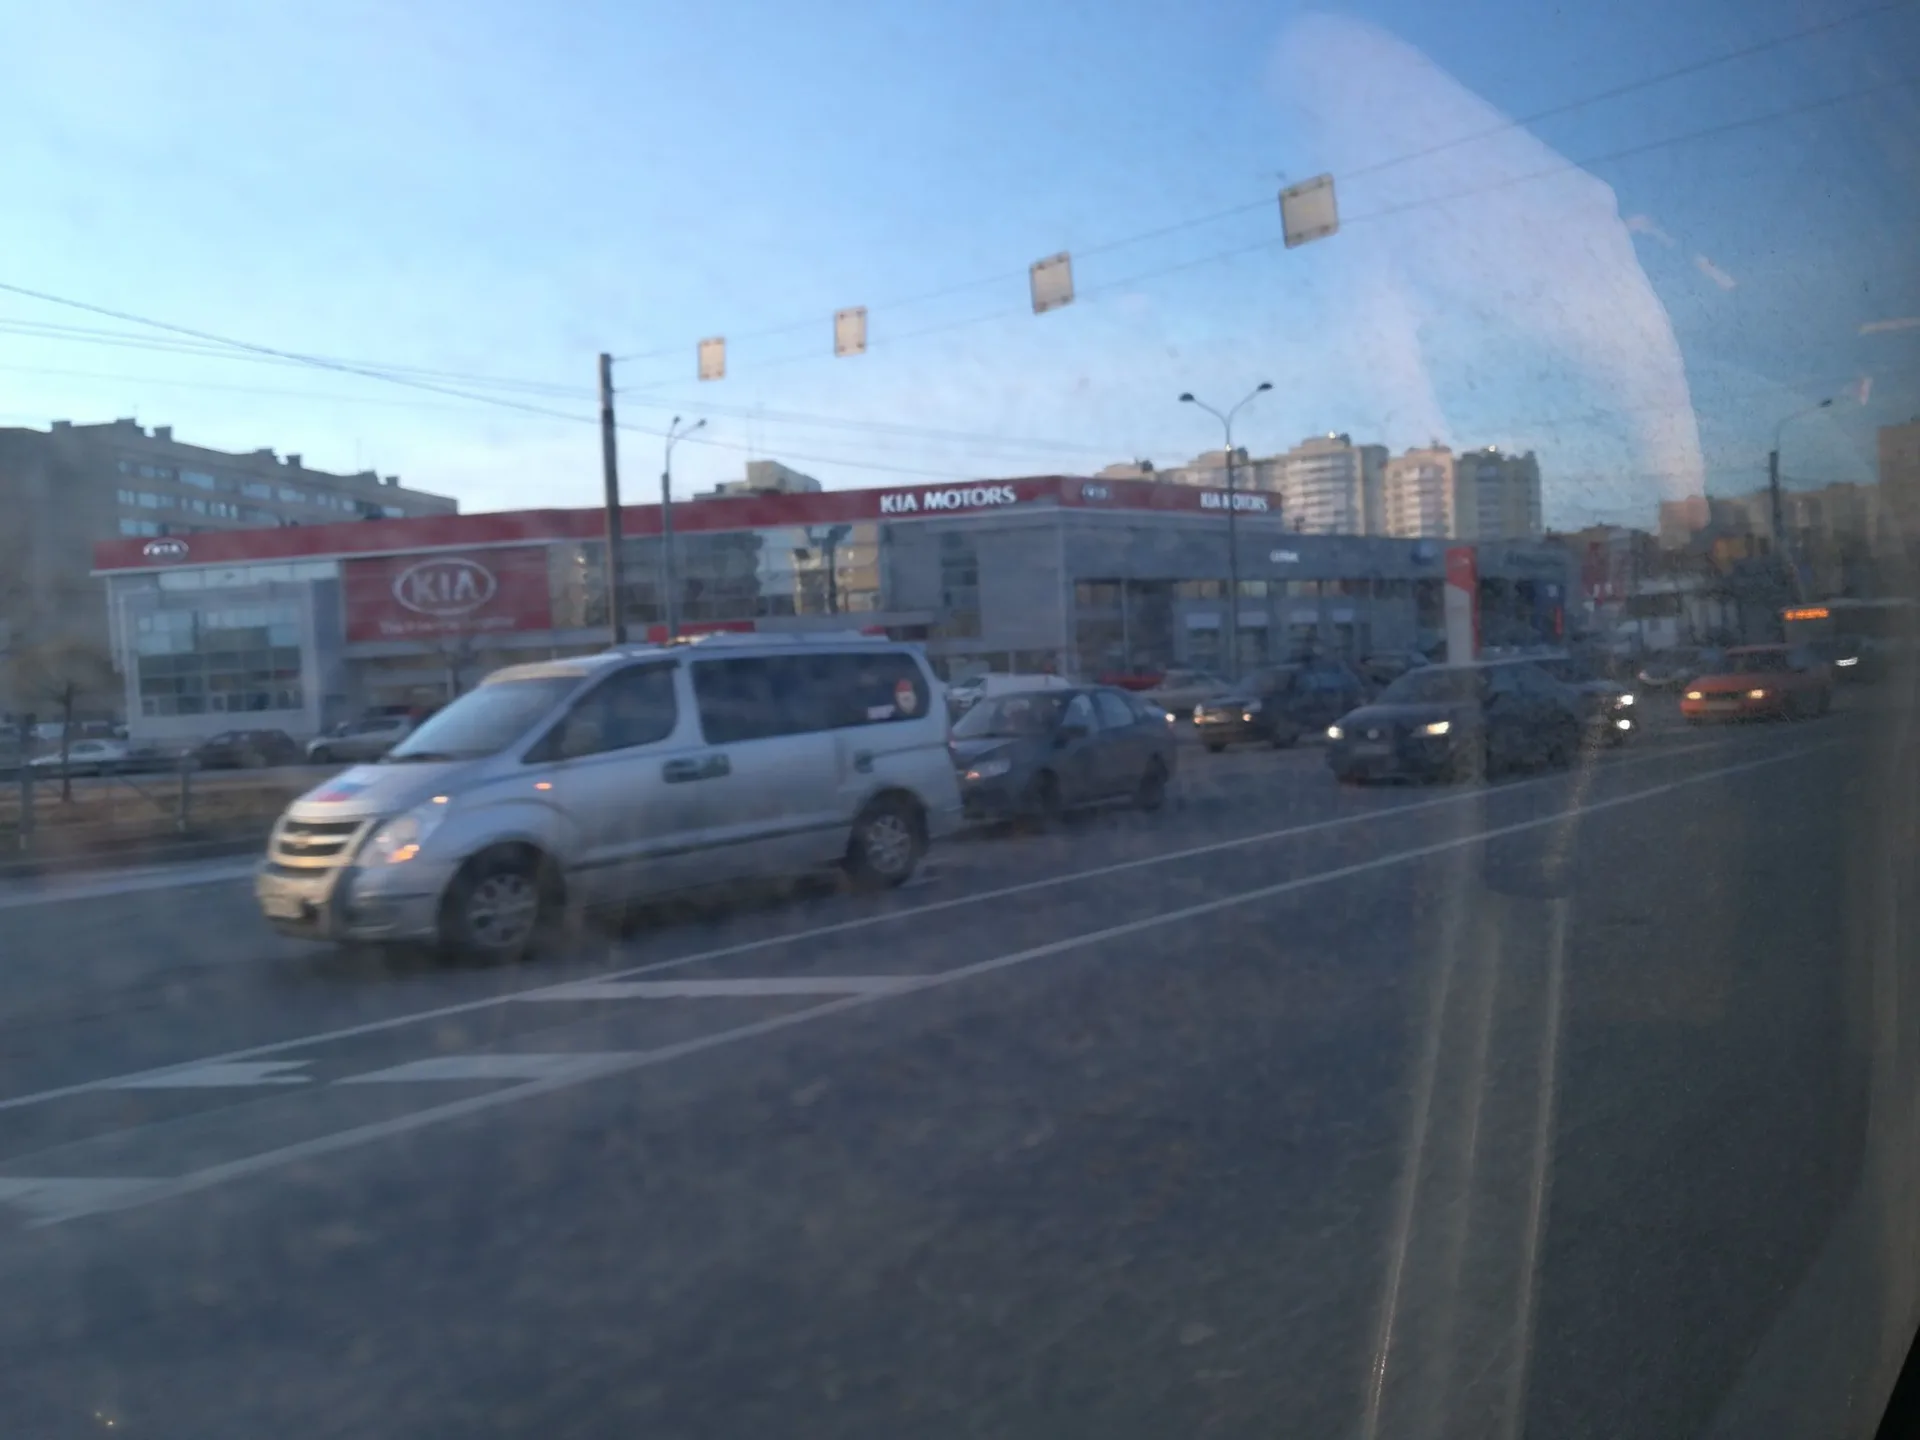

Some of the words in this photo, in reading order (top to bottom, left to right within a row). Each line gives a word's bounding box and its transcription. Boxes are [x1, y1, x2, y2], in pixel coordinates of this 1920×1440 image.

[880, 492, 918, 513] KIA
[923, 484, 1017, 511] MOTORS
[410, 569, 481, 603] KIA
